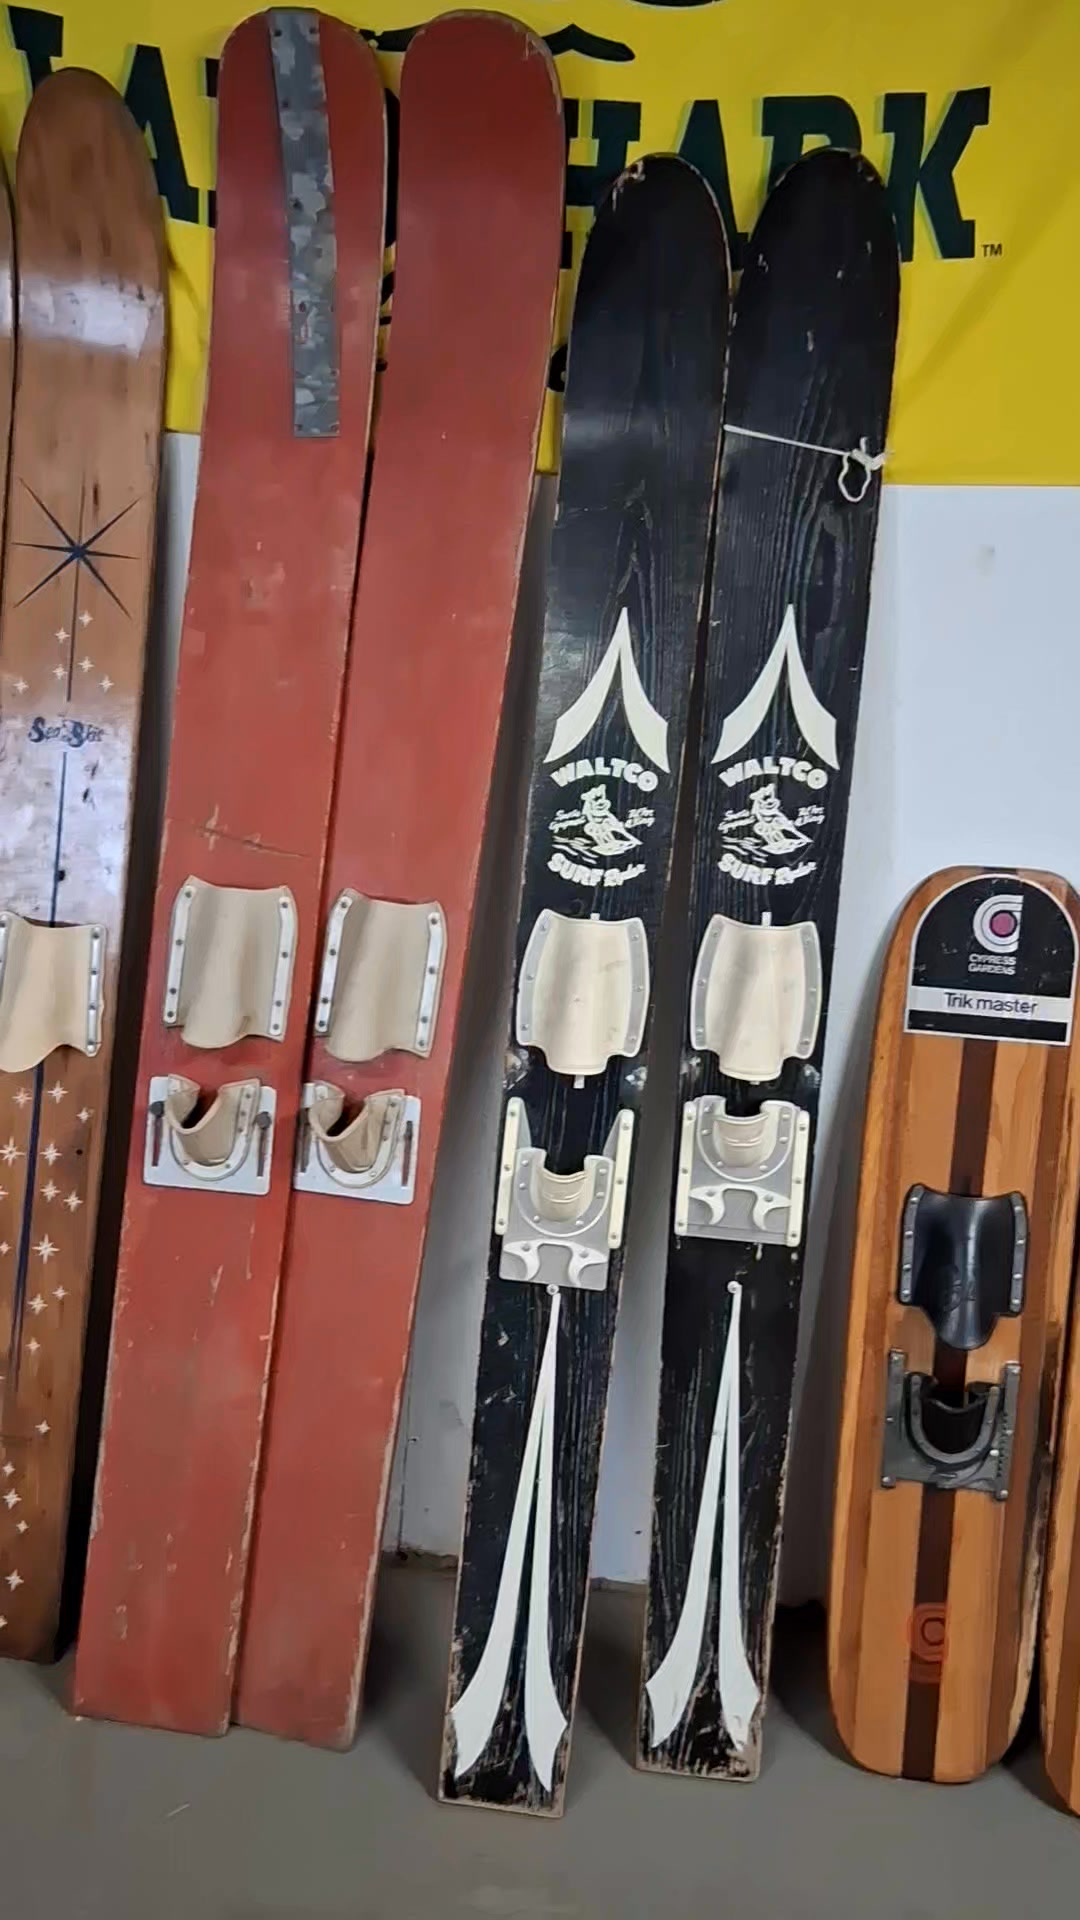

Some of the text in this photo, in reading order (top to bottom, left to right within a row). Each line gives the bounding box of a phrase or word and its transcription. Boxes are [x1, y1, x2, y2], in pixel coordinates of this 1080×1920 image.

[982, 243, 1003, 258] TM
[550, 757, 659, 792] WALTCO
[718, 755, 829, 790] WALTCO
[547, 852, 604, 887] SURF
[717, 852, 776, 886] SURF
[967, 962, 1016, 976] GARDENS
[968, 953, 1017, 966] CYPRESS
[944, 992, 1038, 1015] Trik master
